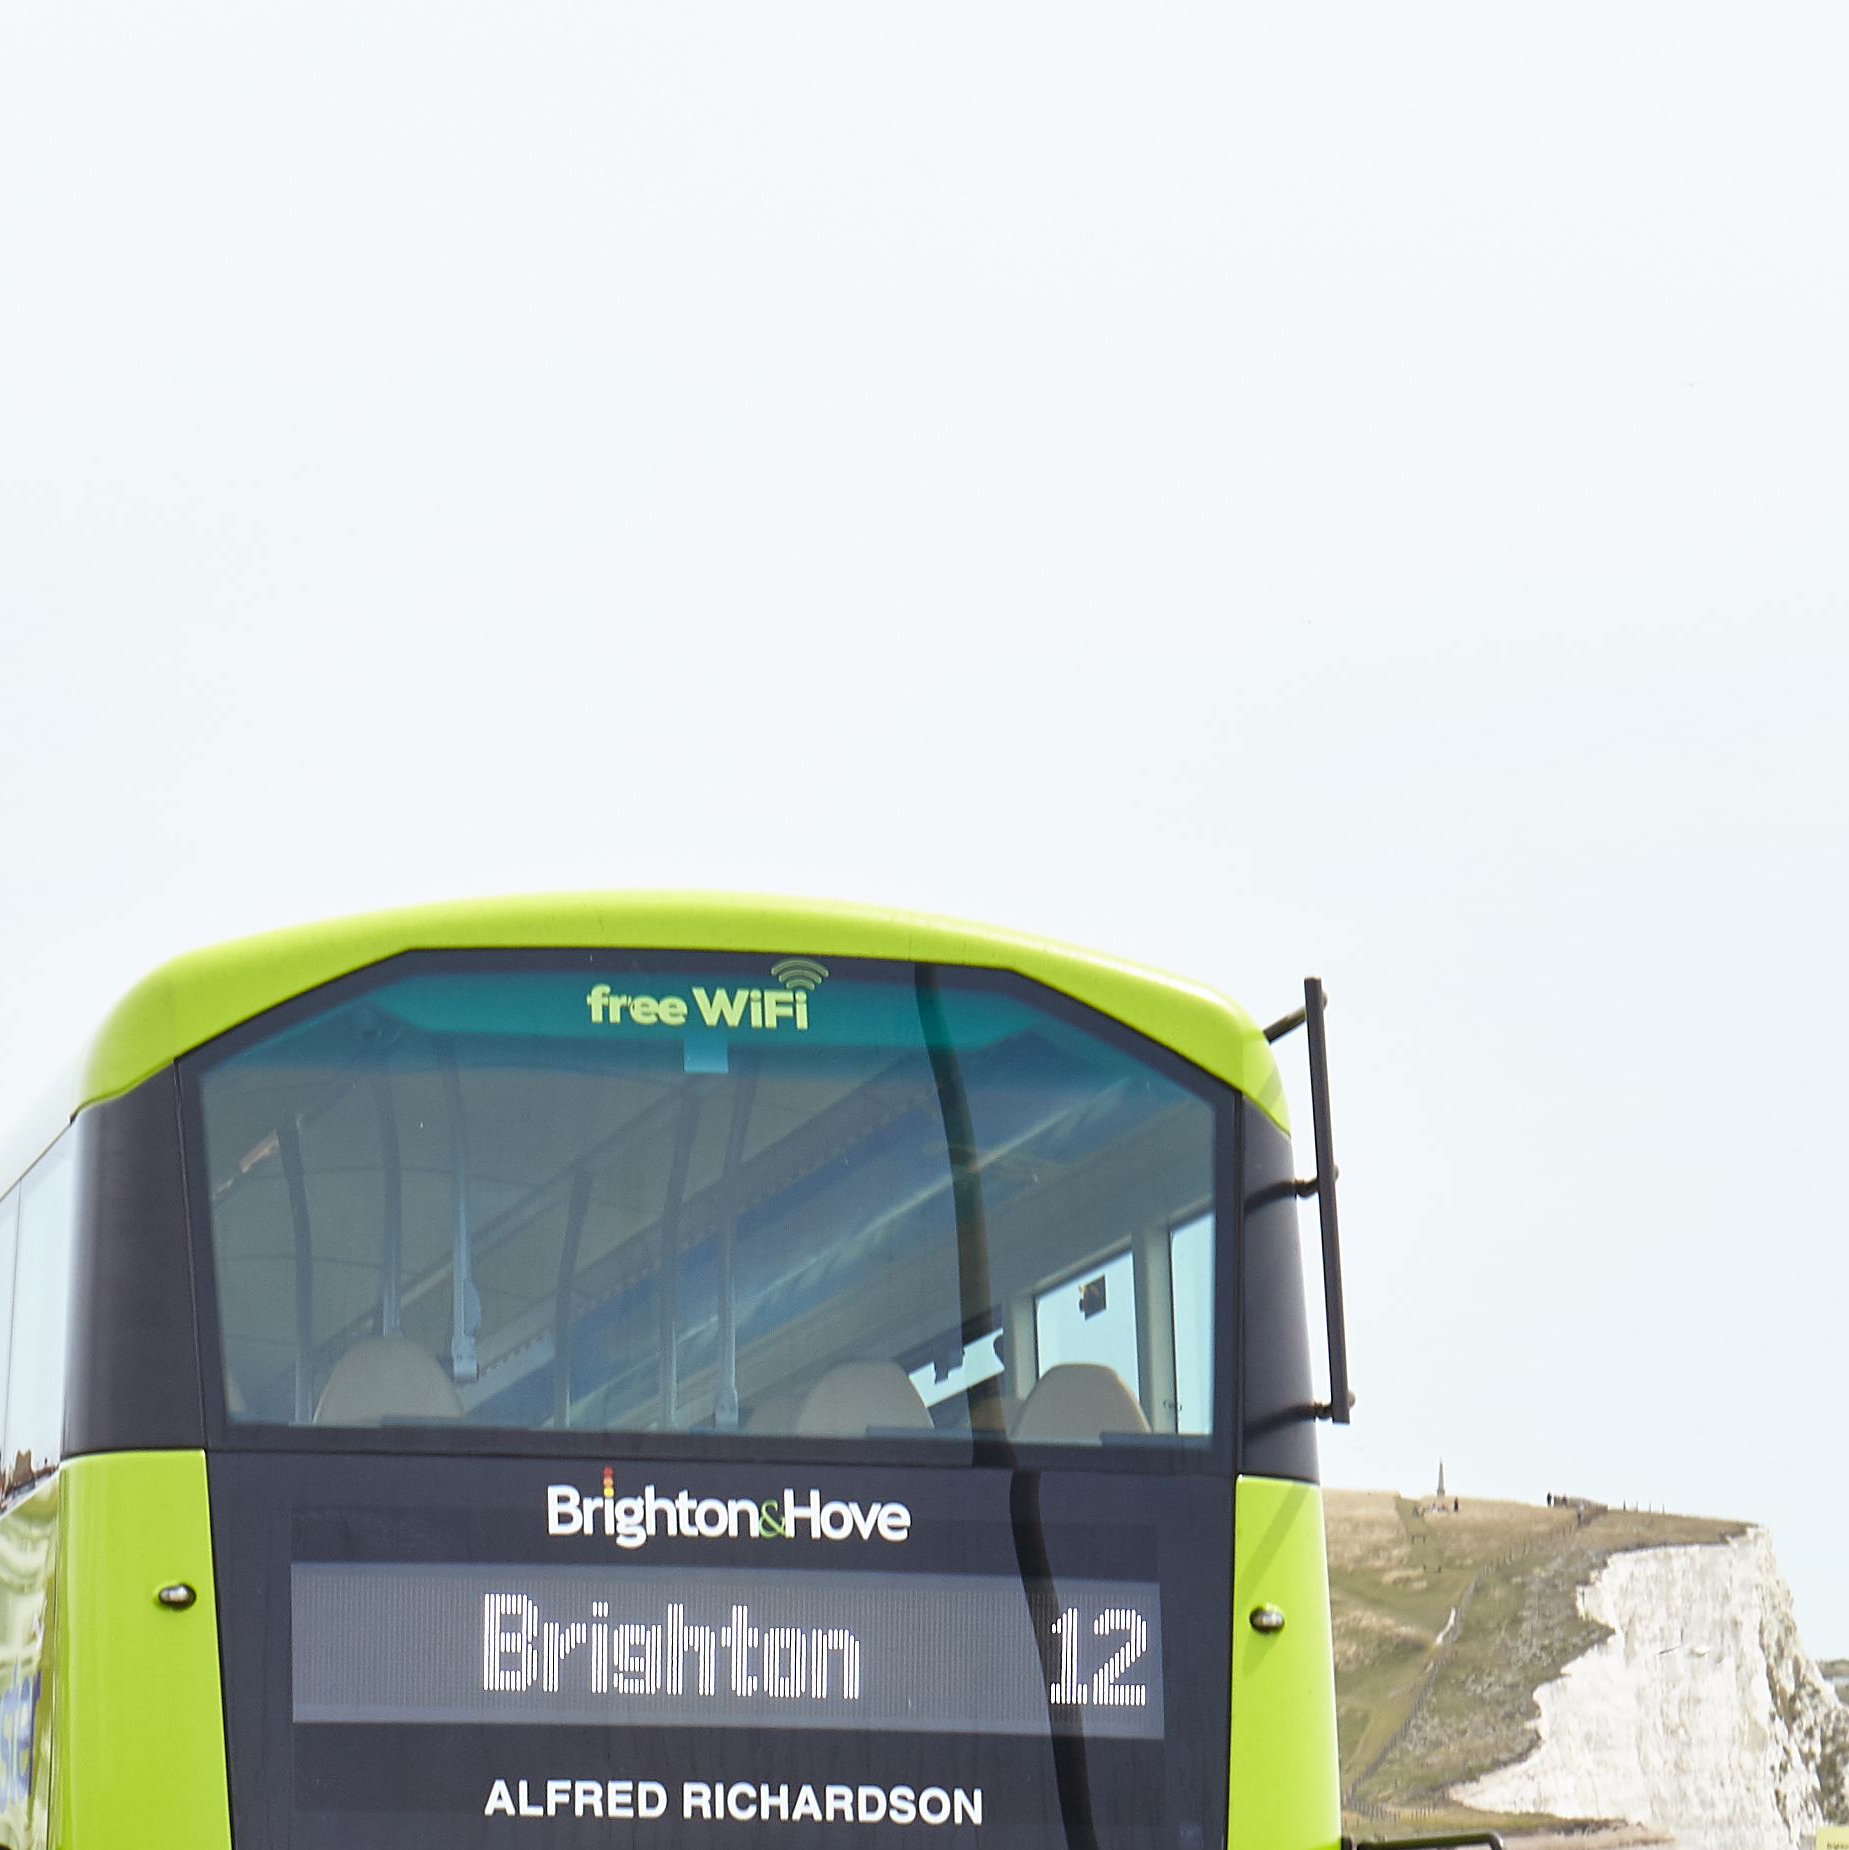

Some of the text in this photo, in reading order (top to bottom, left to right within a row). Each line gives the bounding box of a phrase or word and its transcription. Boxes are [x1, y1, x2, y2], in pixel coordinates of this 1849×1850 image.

[586, 983, 809, 1030] free WiFi
[483, 1593, 860, 1700] Brighton
[1051, 1607, 1147, 1706] 12
[484, 1778, 983, 1826] ALFRED RICHARDSON
